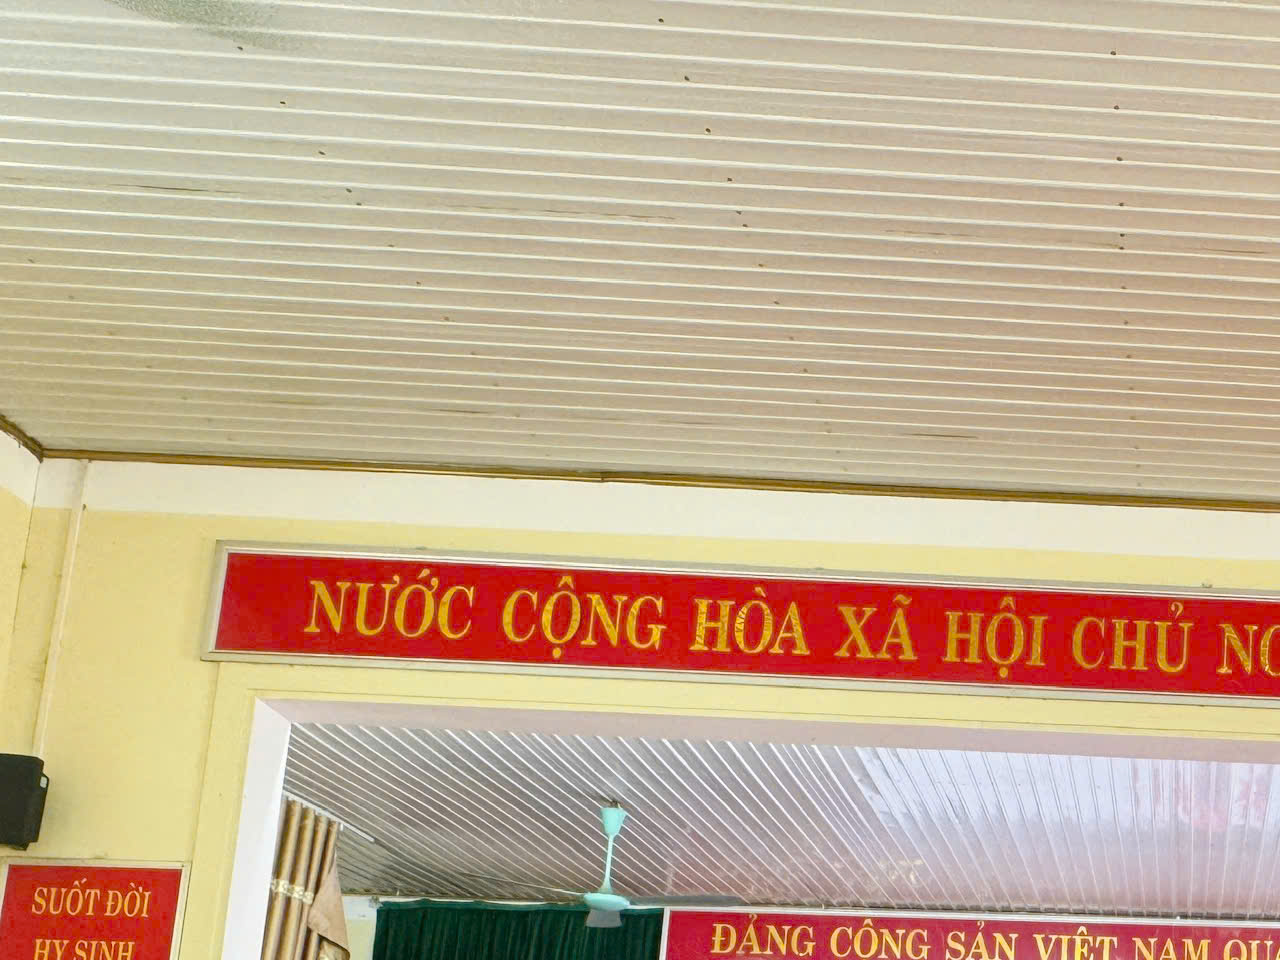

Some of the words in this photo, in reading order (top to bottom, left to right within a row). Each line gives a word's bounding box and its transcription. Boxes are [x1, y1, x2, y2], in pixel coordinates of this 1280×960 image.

[303, 570, 475, 640] NƯỚC
[502, 575, 667, 658] CỘNG
[688, 586, 811, 656] HÒA
[834, 594, 918, 661] XÃ
[943, 596, 1048, 677] HỘI
[1072, 602, 1194, 673] CHỦ
[31, 877, 101, 916] SUỐT
[104, 881, 152, 918] ĐỜI
[710, 913, 816, 957] ĐẢNG
